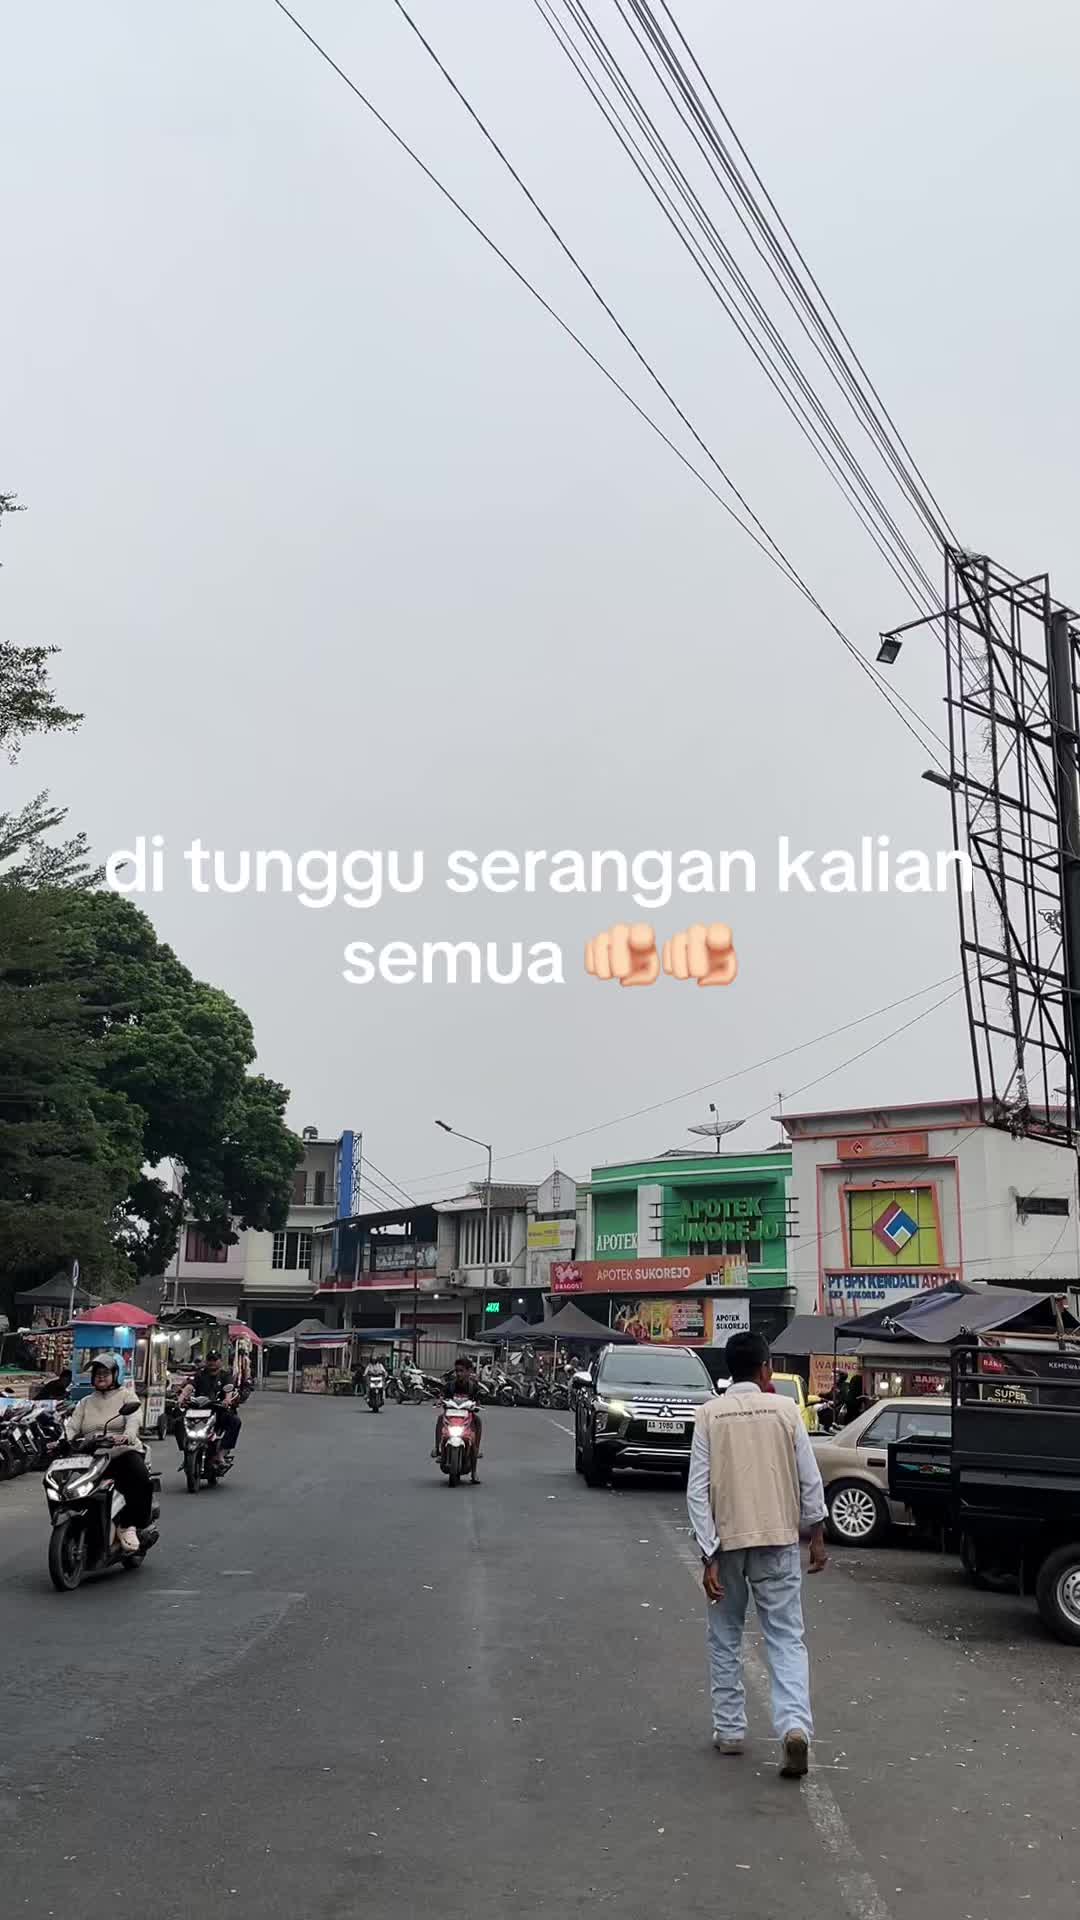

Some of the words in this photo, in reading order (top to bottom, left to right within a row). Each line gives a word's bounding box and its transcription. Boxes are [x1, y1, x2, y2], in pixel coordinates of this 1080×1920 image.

[680, 1197, 762, 1218] APOTEK
[596, 1232, 638, 1252] APOTEK
[596, 1269, 633, 1281] APOTEK
[635, 1266, 691, 1280] SUKOREJO
[828, 1274, 841, 1288] PT
[844, 1274, 867, 1288] BPR
[868, 1274, 920, 1289] KENDALI
[715, 1314, 740, 1322] APOTEK
[716, 1322, 749, 1330] SUKOREJO
[815, 1361, 857, 1370] WAUNG
[994, 1388, 1027, 1401] SUPER
